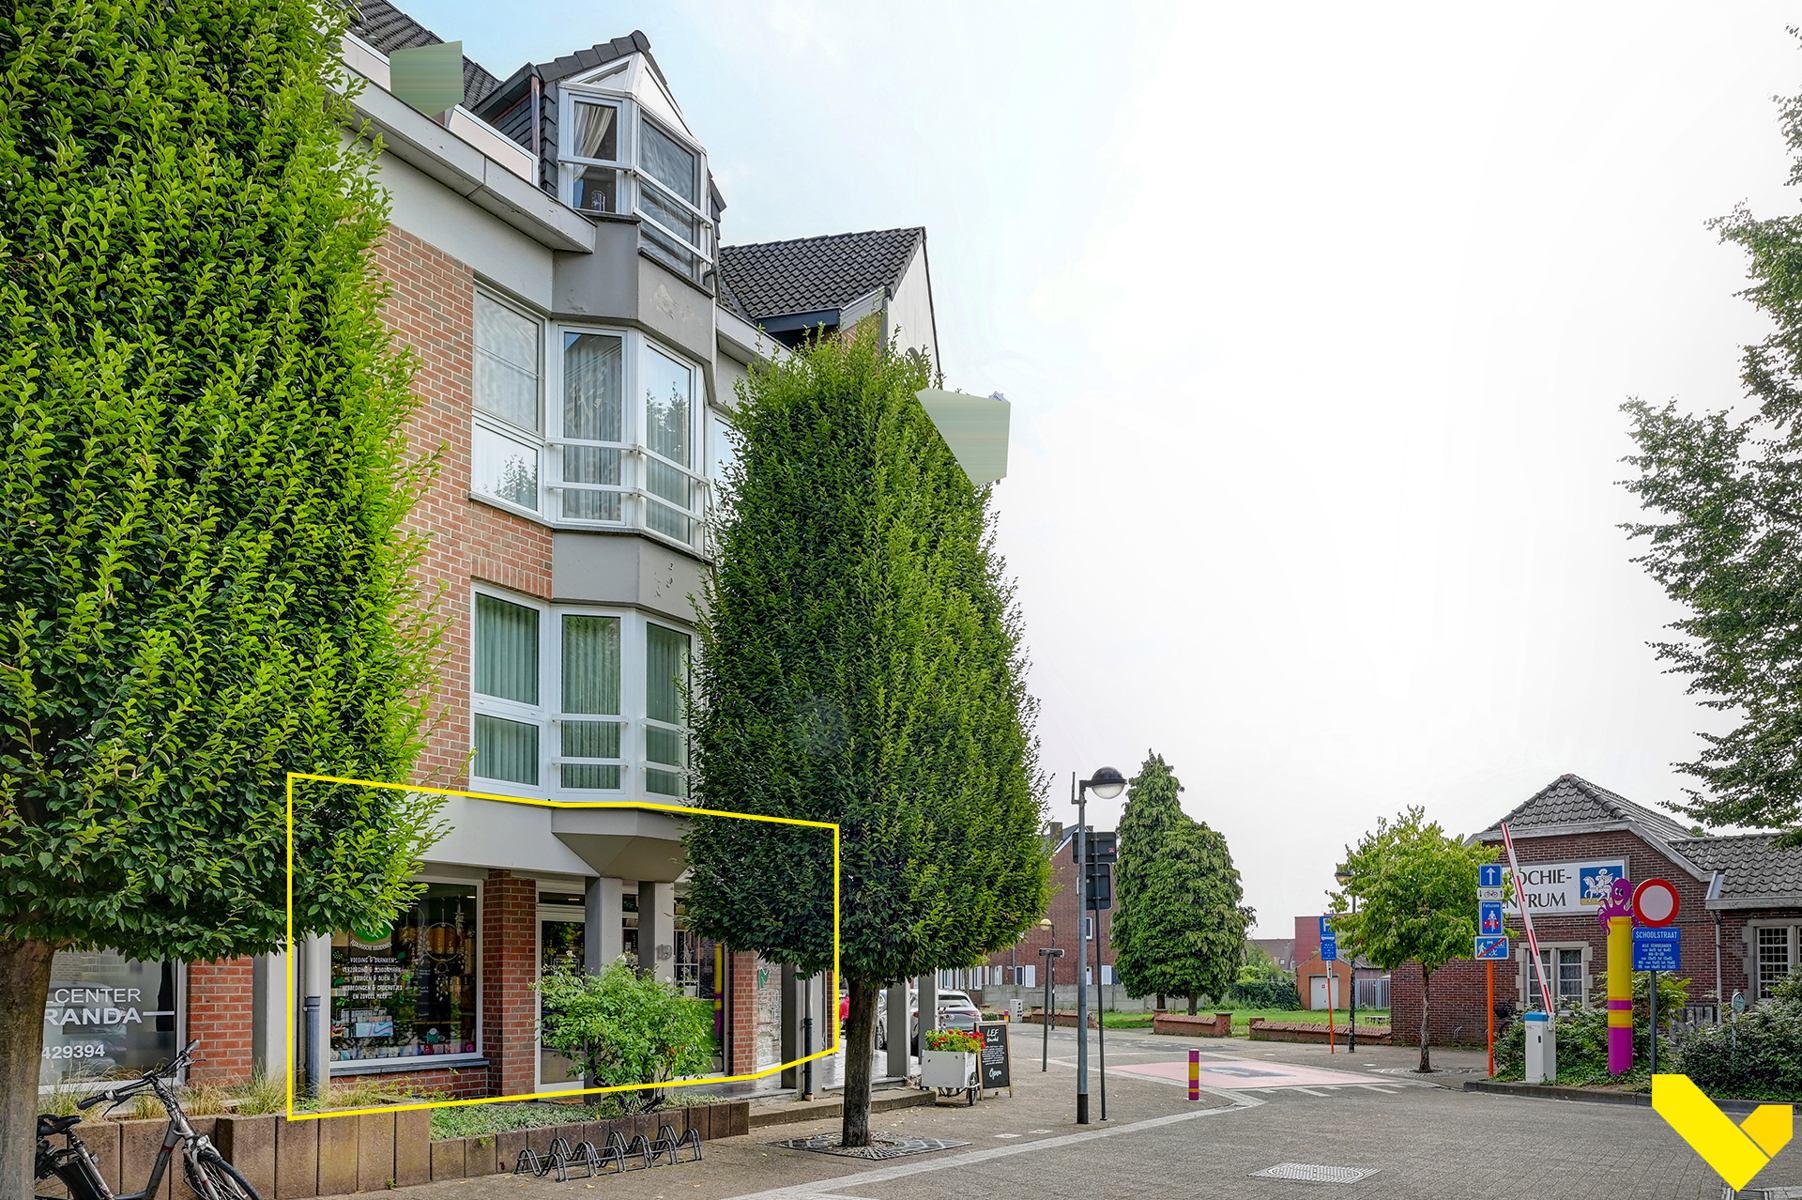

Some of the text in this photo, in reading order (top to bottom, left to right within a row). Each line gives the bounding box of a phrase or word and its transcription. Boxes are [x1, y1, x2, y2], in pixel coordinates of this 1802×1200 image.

[1635, 931, 1678, 939] SCHOOLSTRAAT
[46, 988, 142, 1004] CENTER
[986, 1029, 999, 1037] LEF
